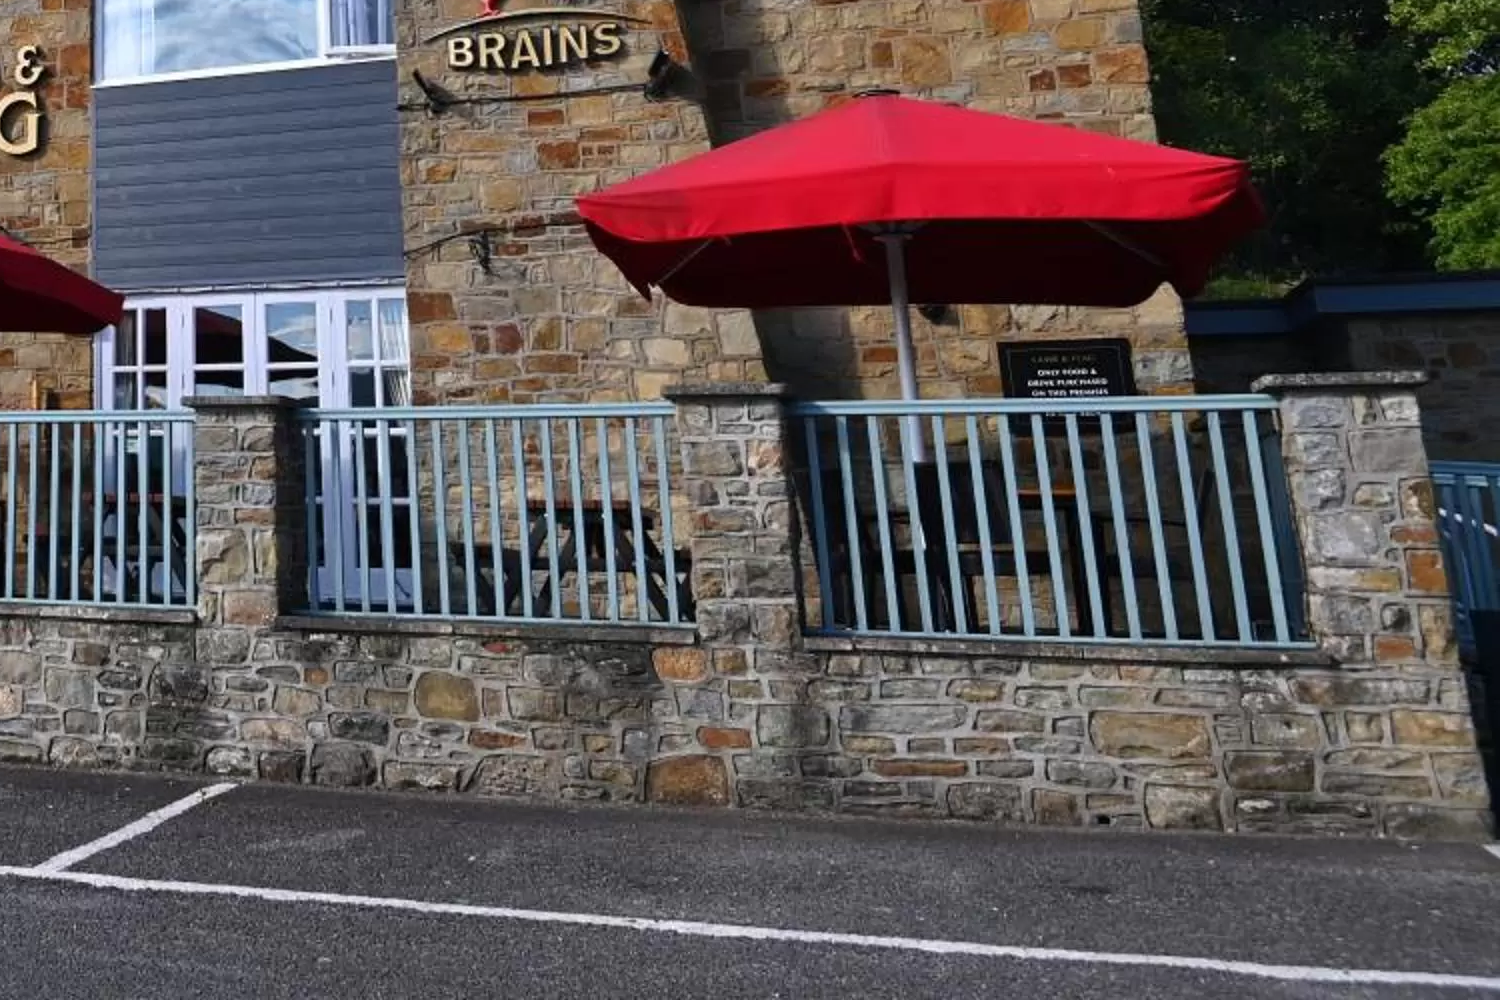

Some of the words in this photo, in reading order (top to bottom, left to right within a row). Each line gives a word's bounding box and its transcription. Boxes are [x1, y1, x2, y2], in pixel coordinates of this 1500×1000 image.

[448, 23, 622, 70] BRAINS
[14, 45, 44, 86] &
[1027, 379, 1054, 387] DRINK
[1037, 369, 1060, 377] ONLY
